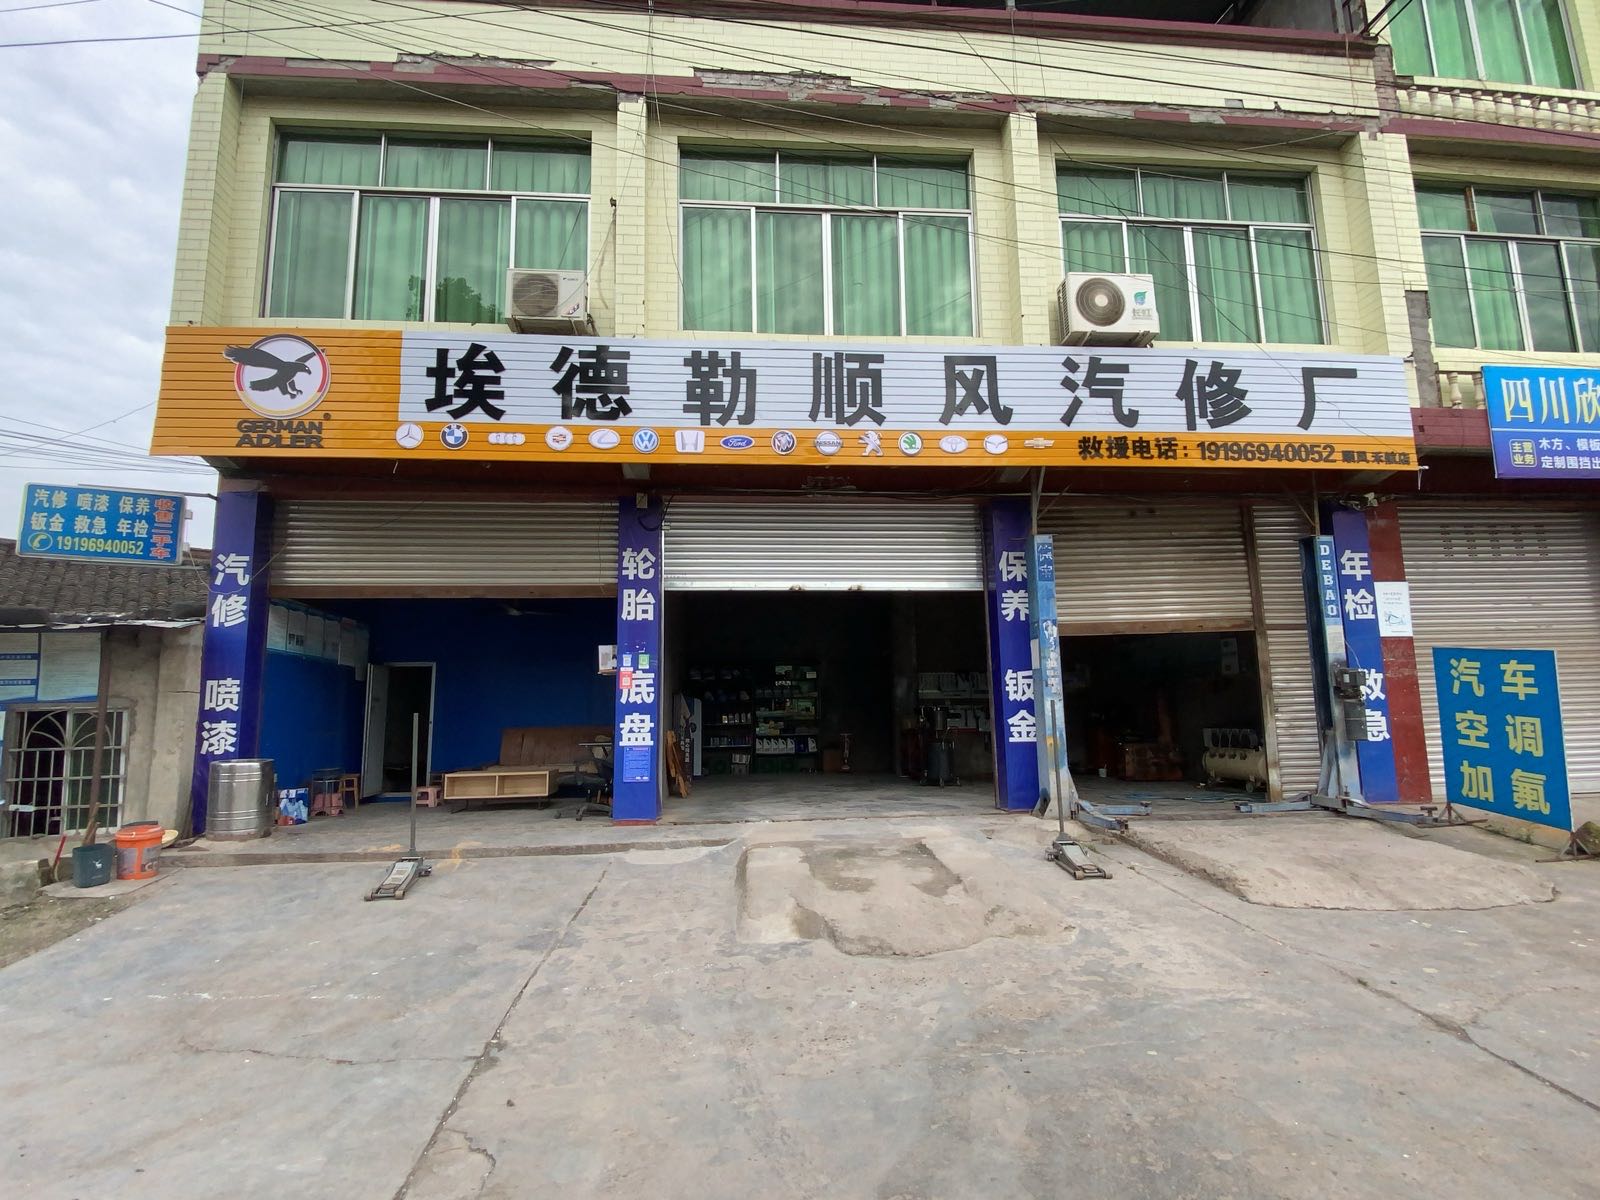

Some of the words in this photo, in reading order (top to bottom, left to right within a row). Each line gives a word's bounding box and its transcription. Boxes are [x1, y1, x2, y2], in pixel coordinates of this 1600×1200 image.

[425, 343, 1357, 431] 埃德勒顺风汽修厂
[236, 434, 324, 448] ADLER
[237, 420, 322, 434] GERMAN
[1197, 441, 1336, 463] 19196940052
[30, 512, 65, 533] 钣金
[75, 515, 107, 535] 救急
[117, 518, 149, 538] 年检
[33, 489, 67, 509] 汽修
[77, 492, 110, 513] 喷漆
[119, 496, 150, 515] 保养
[57, 535, 144, 555] 19196940052
[211, 553, 249, 628] 汽修
[621, 547, 656, 621] 轮胎
[999, 551, 1030, 622] 保养
[1341, 549, 1376, 621] 年检
[619, 670, 655, 747] 底盘
[1004, 669, 1037, 743] 钣金
[1450, 658, 1539, 701] 汽车
[201, 678, 240, 755] 喷漆
[1455, 710, 1545, 758] 空调
